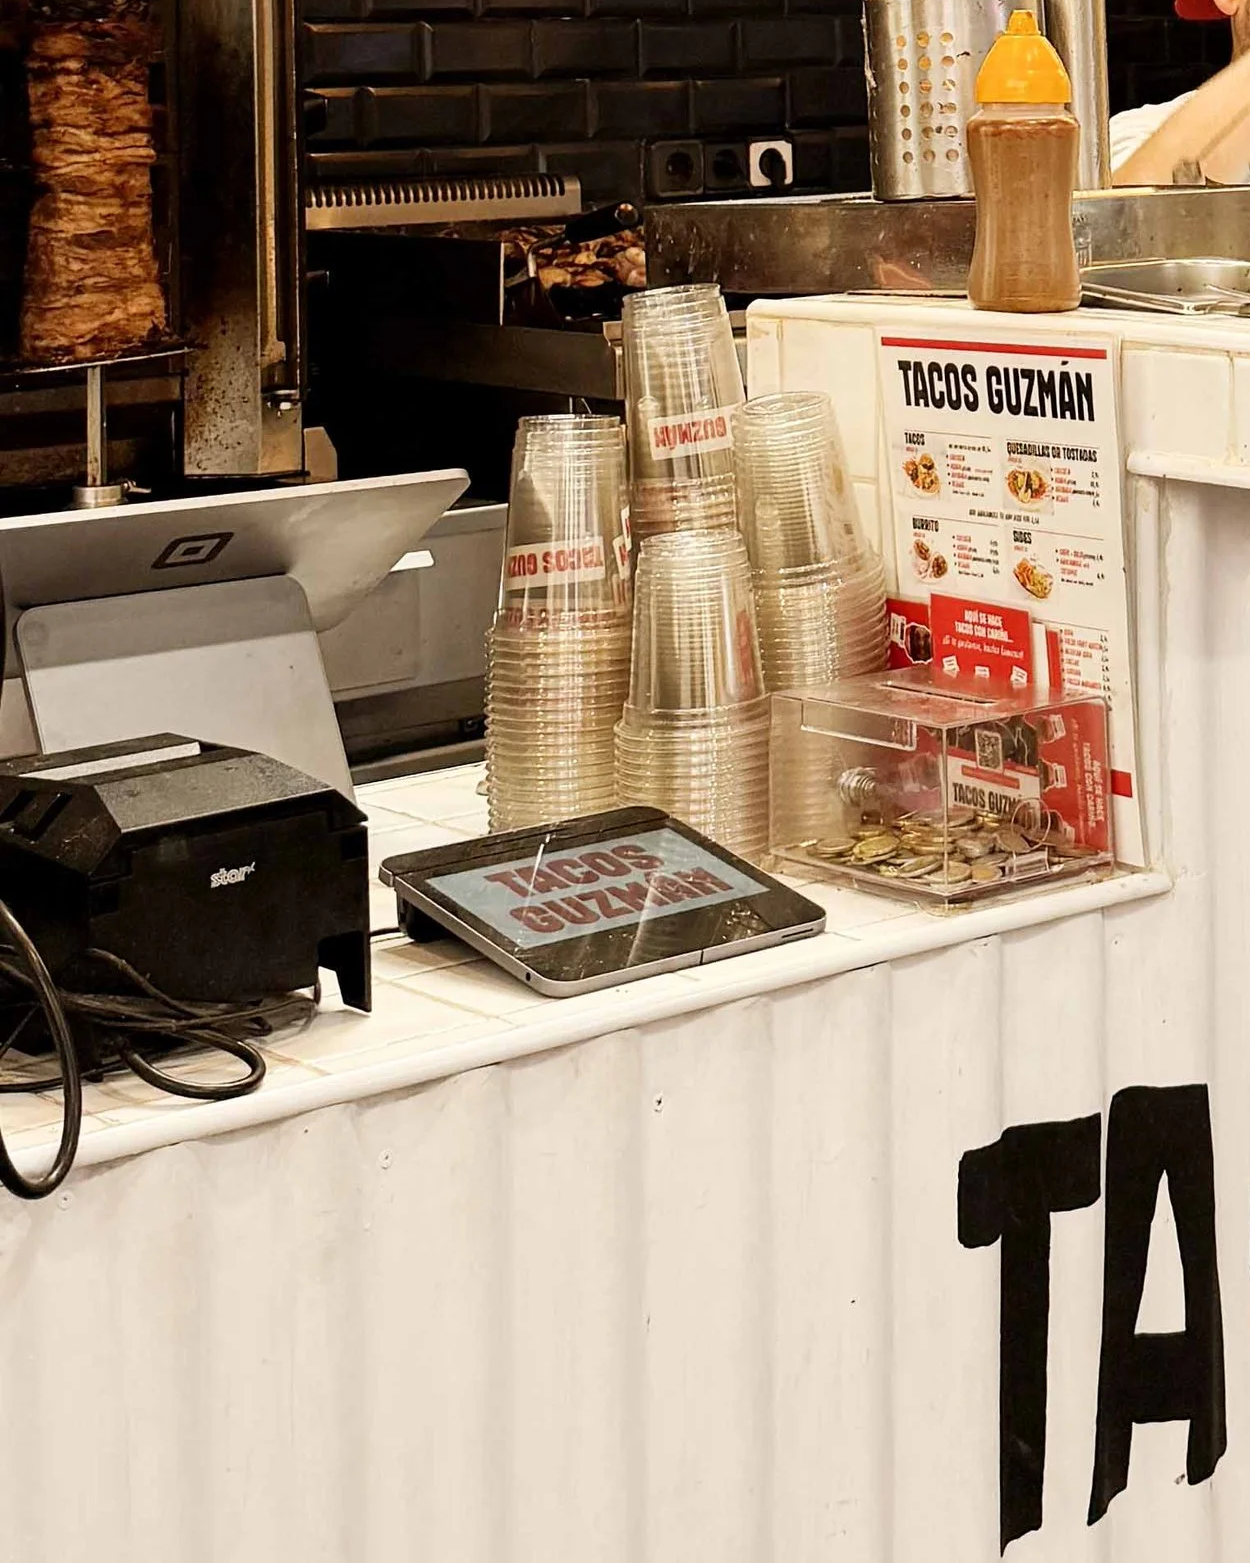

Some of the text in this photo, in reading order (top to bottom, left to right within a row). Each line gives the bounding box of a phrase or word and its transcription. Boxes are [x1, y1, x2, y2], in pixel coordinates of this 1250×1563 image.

[898, 360, 1095, 422] TACOS GUZMÁN
[904, 432, 926, 446] TACOS
[1006, 441, 1051, 458] QUESADILLAS
[1062, 448, 1098, 462] TOSTADAS
[1012, 530, 1032, 544] SIDES
[952, 782, 986, 809] TACOS
[483, 844, 664, 900] TACOS
